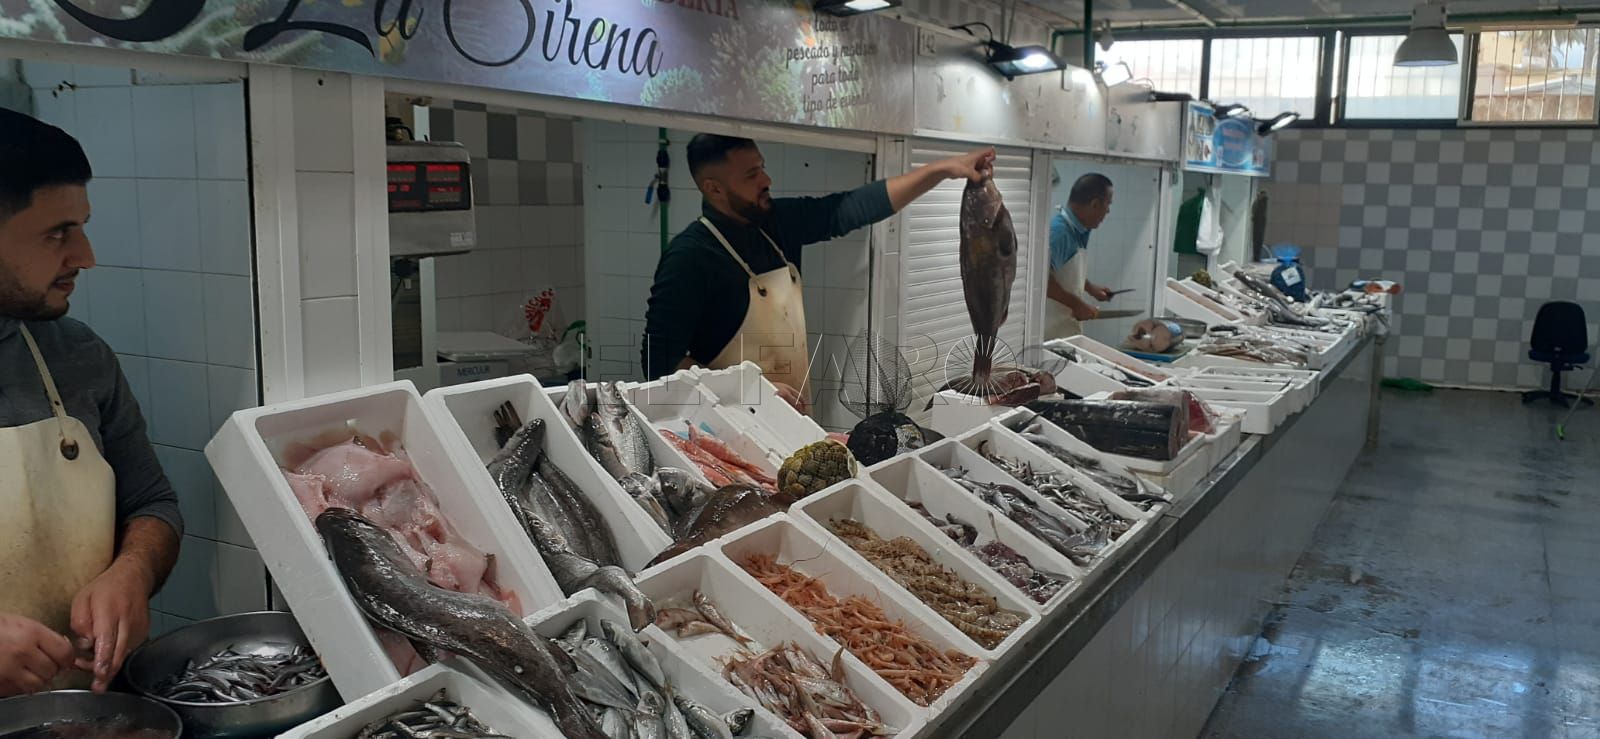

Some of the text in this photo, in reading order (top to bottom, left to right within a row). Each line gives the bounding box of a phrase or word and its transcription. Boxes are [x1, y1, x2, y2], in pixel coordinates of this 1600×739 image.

[786, 40, 829, 66] pescado
[831, 45, 839, 65] y
[811, 69, 836, 93] para
[803, 93, 823, 117] tipo
[826, 91, 838, 110] de
